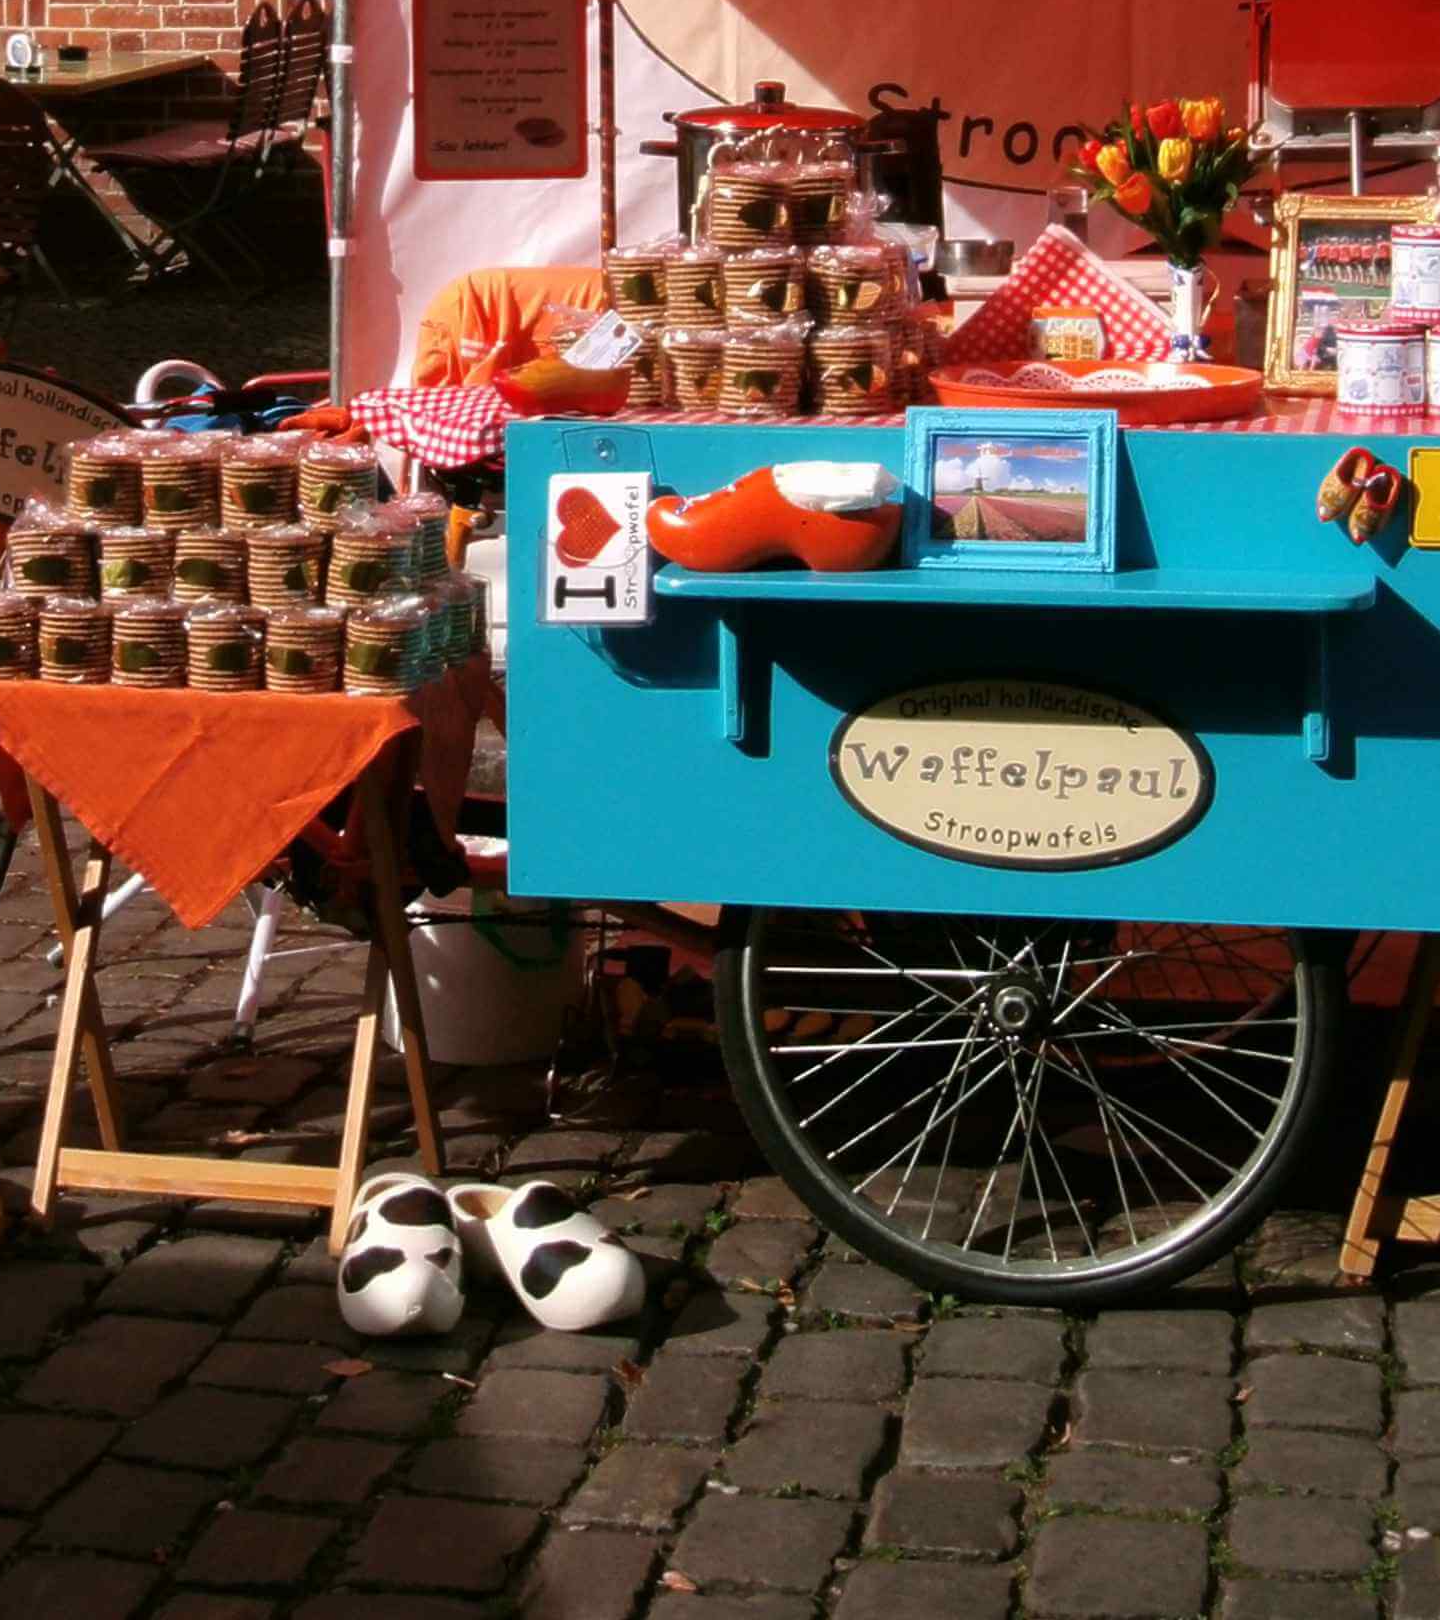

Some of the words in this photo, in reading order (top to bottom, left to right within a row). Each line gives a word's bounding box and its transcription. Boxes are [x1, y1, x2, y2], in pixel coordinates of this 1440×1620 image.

[554, 573, 617, 612] I
[898, 688, 990, 720] Original
[844, 741, 1188, 801] Waffelpaul
[923, 810, 1118, 853] Stroopwafels
